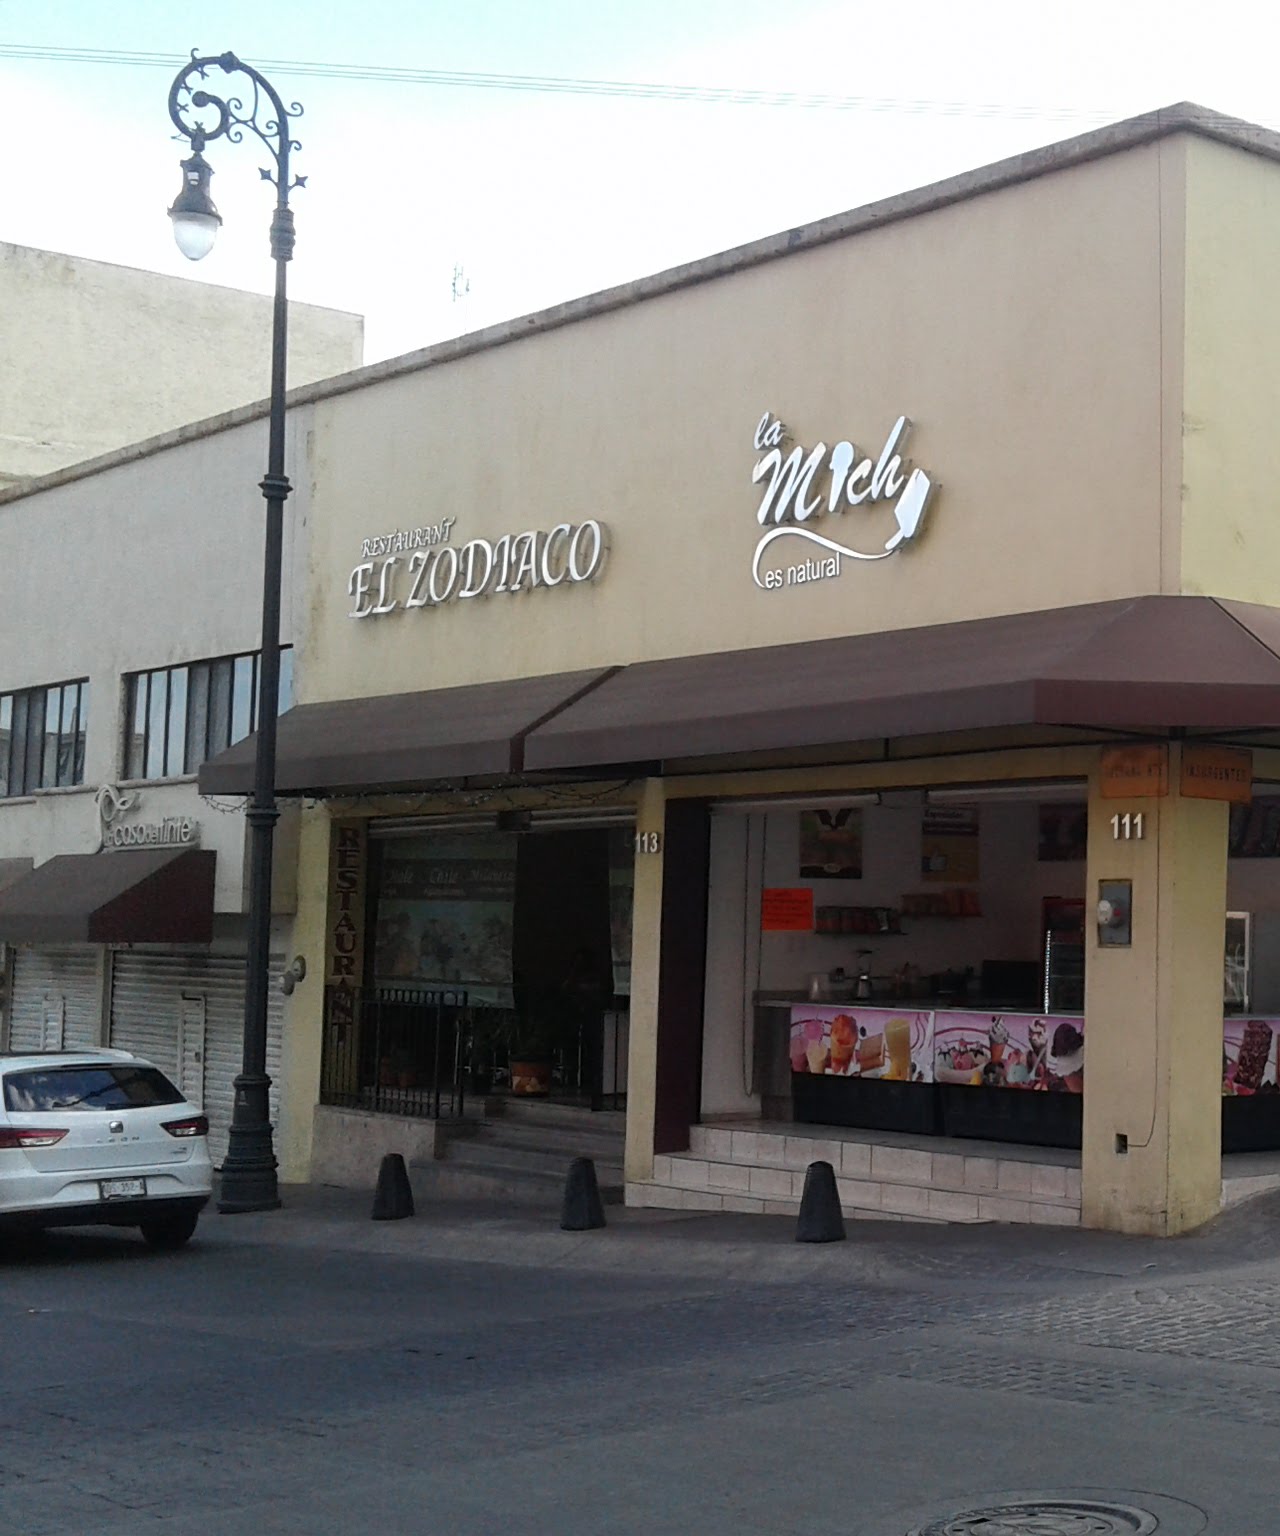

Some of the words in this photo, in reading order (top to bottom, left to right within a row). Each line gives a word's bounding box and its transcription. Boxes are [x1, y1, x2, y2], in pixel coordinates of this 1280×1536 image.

[753, 411, 784, 450] la
[361, 515, 457, 559] RESTAURANT
[347, 556, 400, 618] EL
[405, 519, 606, 608] ZODIACO
[765, 567, 783, 589] es
[787, 552, 841, 586] natural
[635, 831, 659, 854] 113
[1110, 812, 1144, 840] 111
